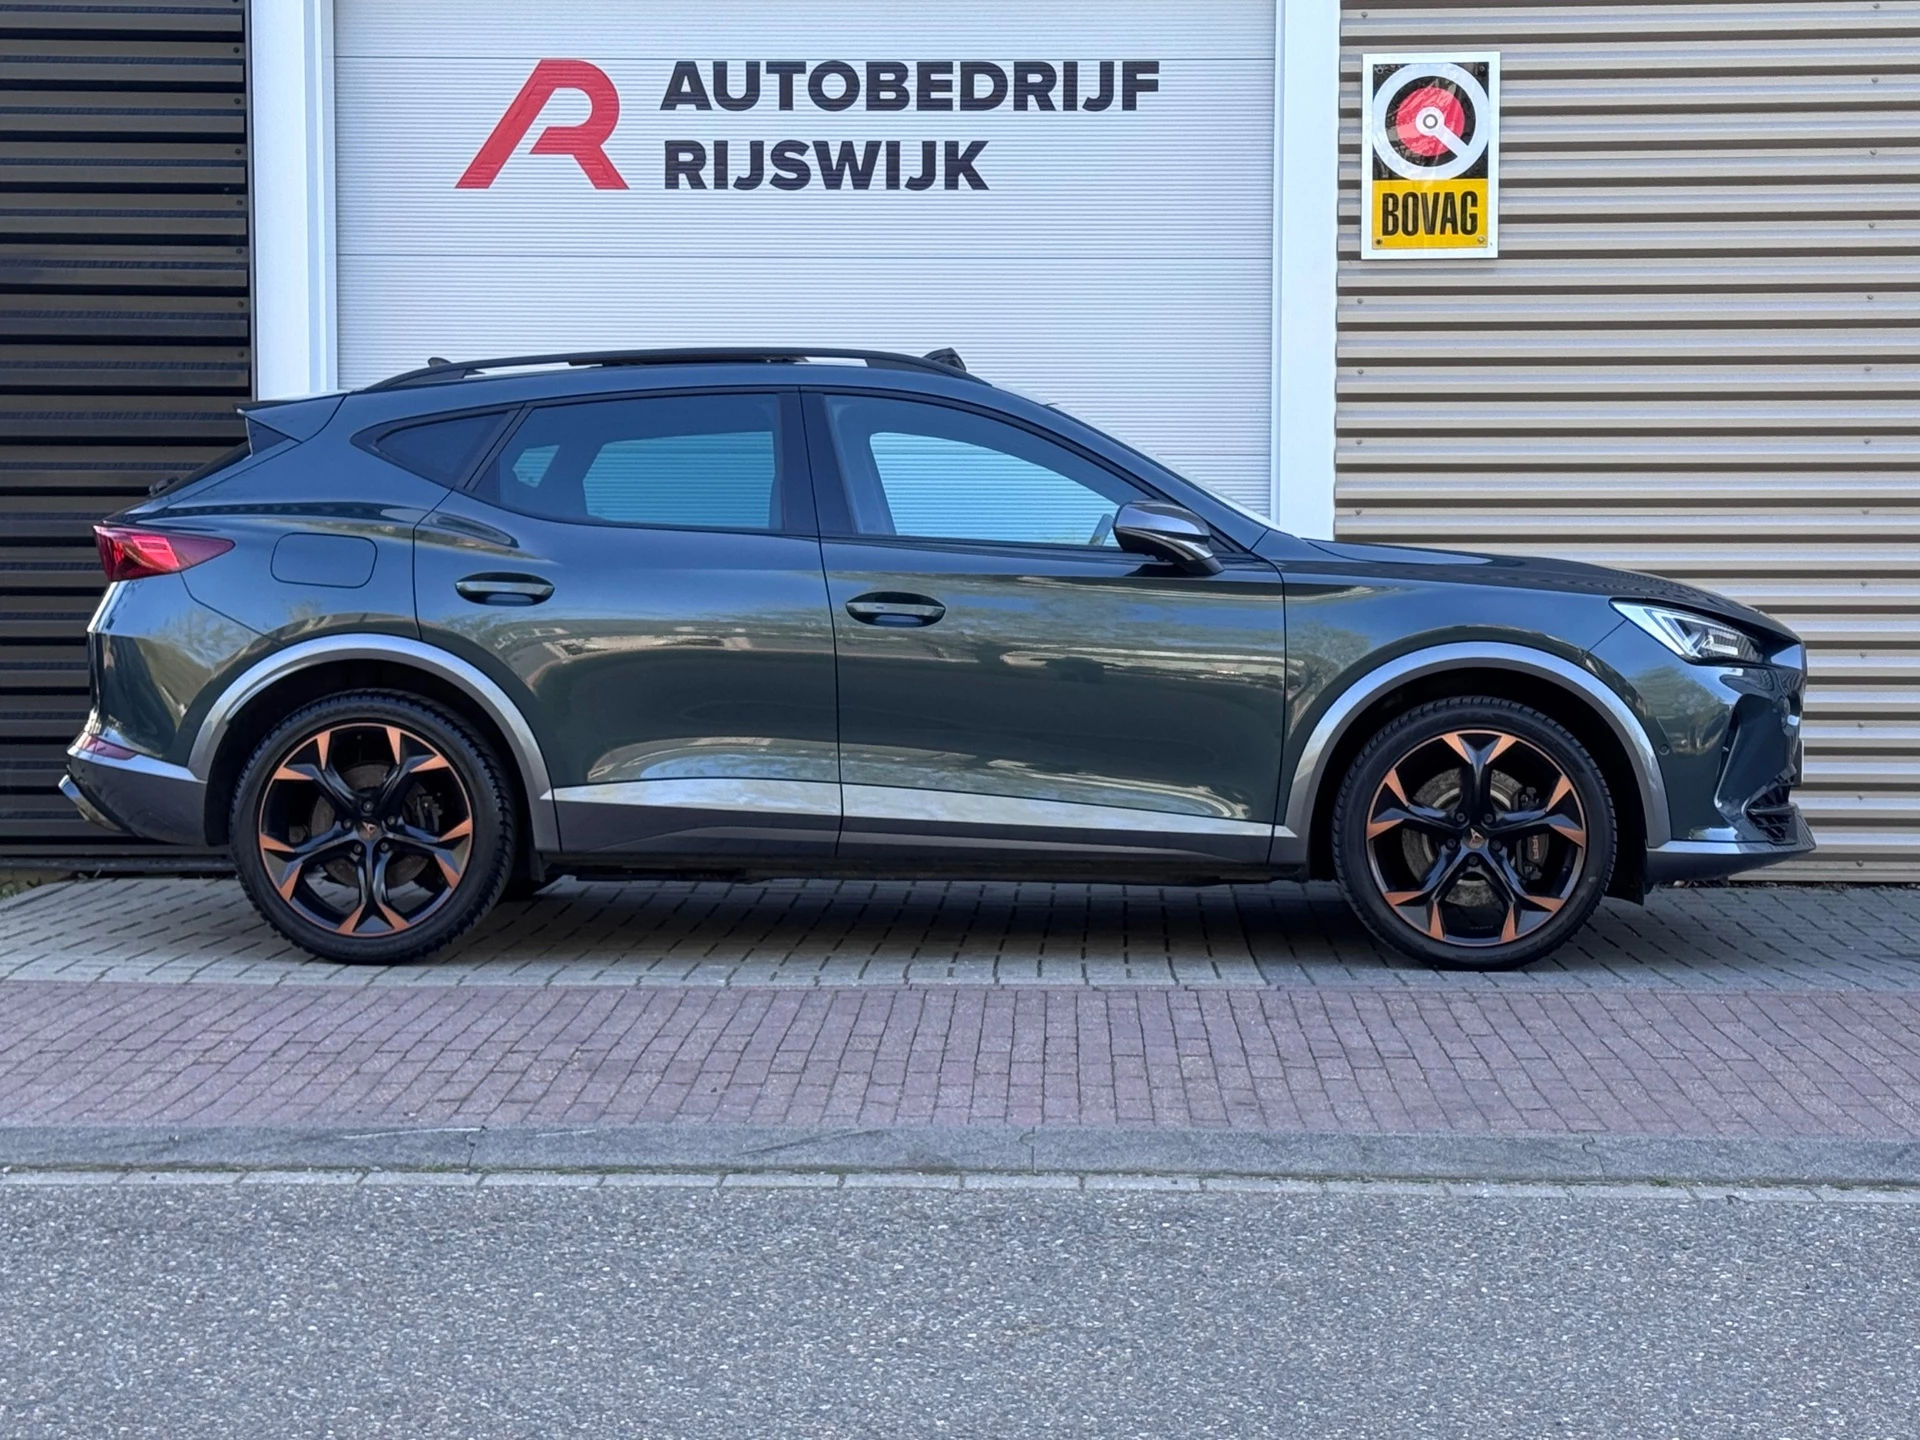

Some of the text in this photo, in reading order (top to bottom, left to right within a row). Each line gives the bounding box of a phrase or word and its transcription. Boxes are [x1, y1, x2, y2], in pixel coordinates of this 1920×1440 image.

[660, 61, 1160, 112] AUTOBEDRIJF
[664, 140, 990, 191] RIJSWIJK
[1382, 191, 1478, 236] BOVAG
